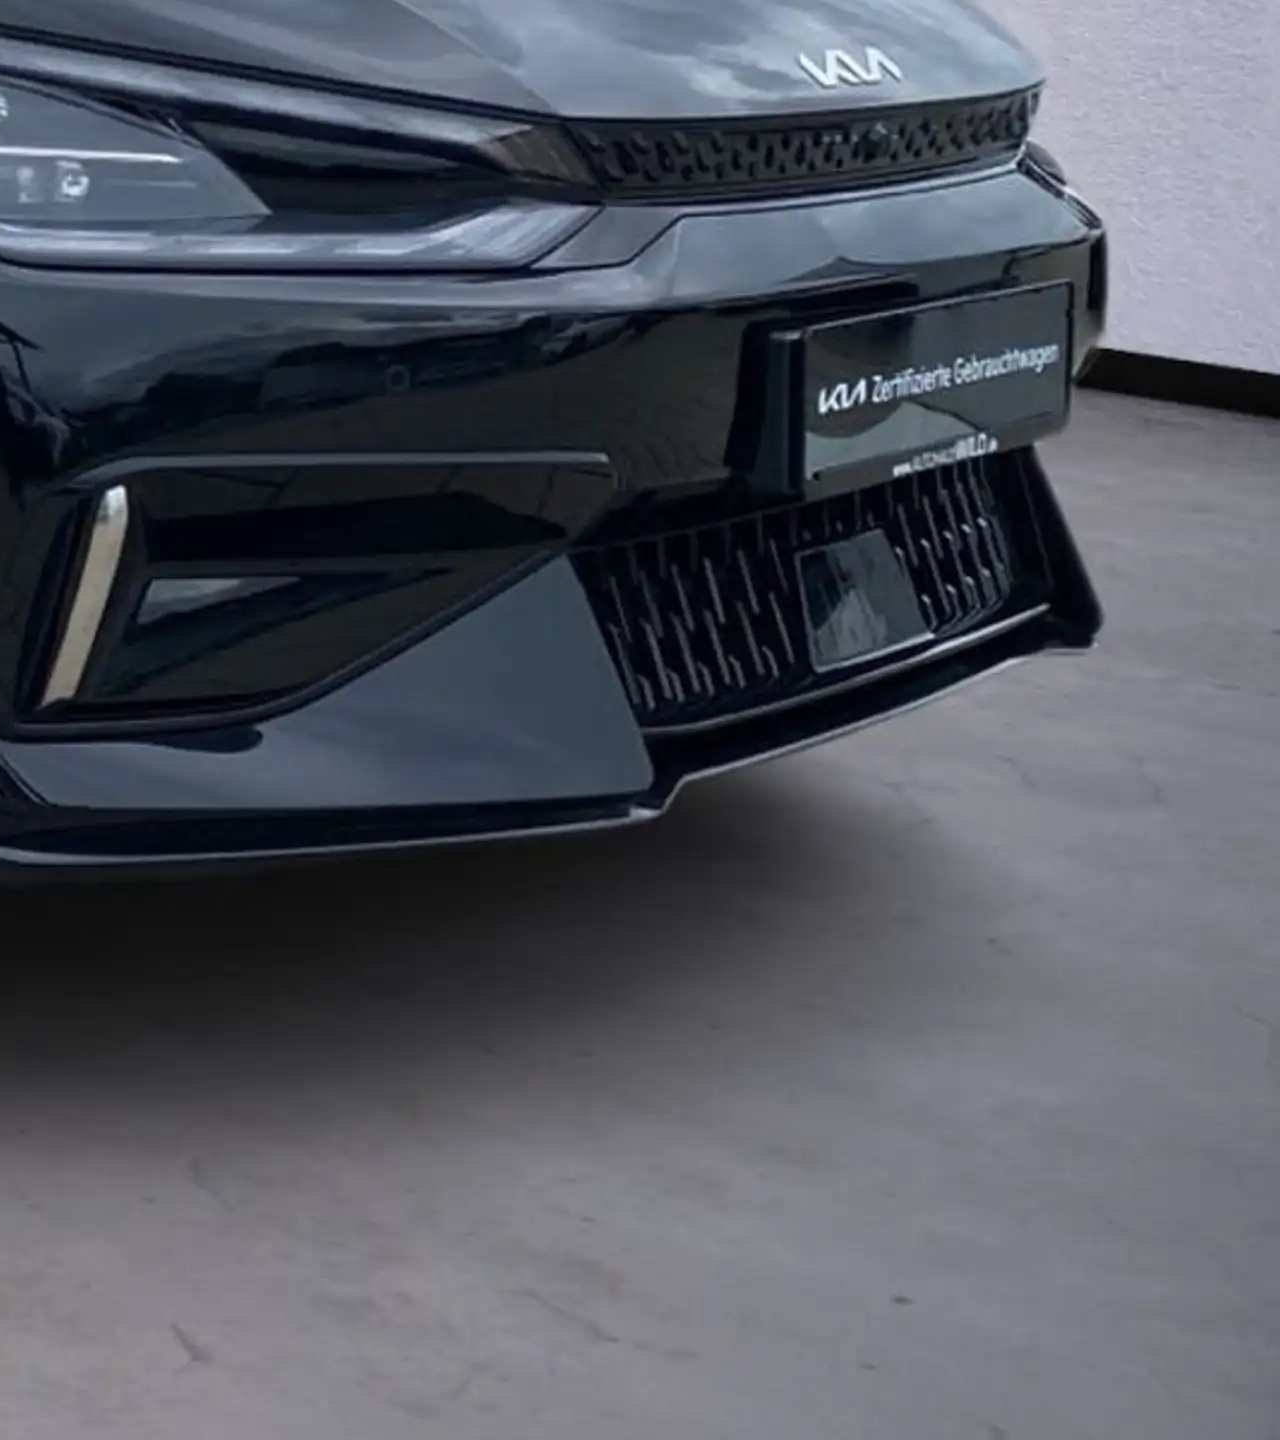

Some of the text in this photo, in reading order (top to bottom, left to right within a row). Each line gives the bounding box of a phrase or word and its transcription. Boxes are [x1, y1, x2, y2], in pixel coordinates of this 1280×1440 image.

[818, 344, 1060, 414] KIA Zertifizierte Gebrauchtwagen
